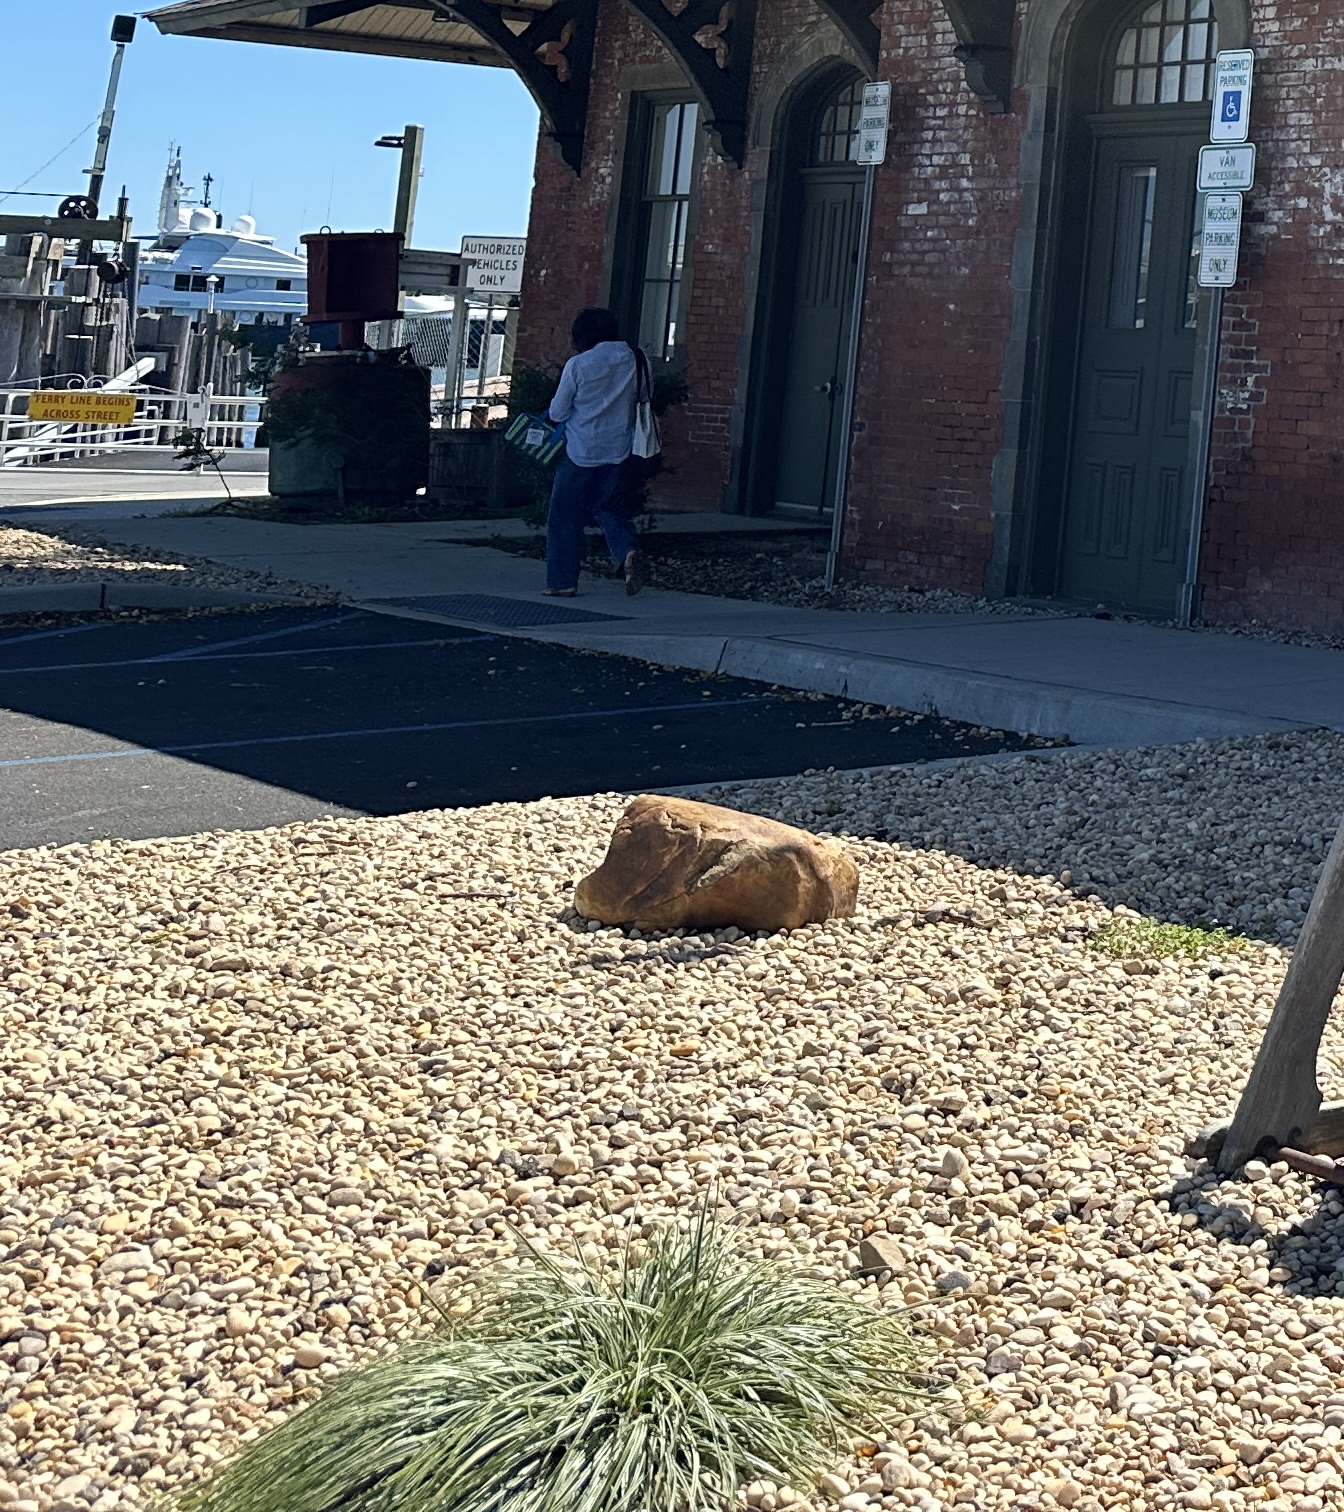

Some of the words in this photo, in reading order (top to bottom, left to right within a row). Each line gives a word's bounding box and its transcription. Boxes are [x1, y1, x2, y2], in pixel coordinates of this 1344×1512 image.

[1220, 75, 1247, 87] PARKING
[1220, 156, 1236, 167] VAN
[1208, 170, 1245, 181] ACCESSIBLE
[1207, 207, 1238, 220] MUSEUM
[1205, 232, 1236, 247] PARKING
[464, 242, 524, 256] AUTHORIZED
[1209, 257, 1229, 273] ONLY
[479, 274, 505, 286] ONLY
[35, 394, 66, 404] FERRY
[70, 395, 92, 405] LINE
[95, 396, 131, 407] BEGINS
[42, 409, 80, 419] ACROSS
[85, 410, 120, 421] STREET
